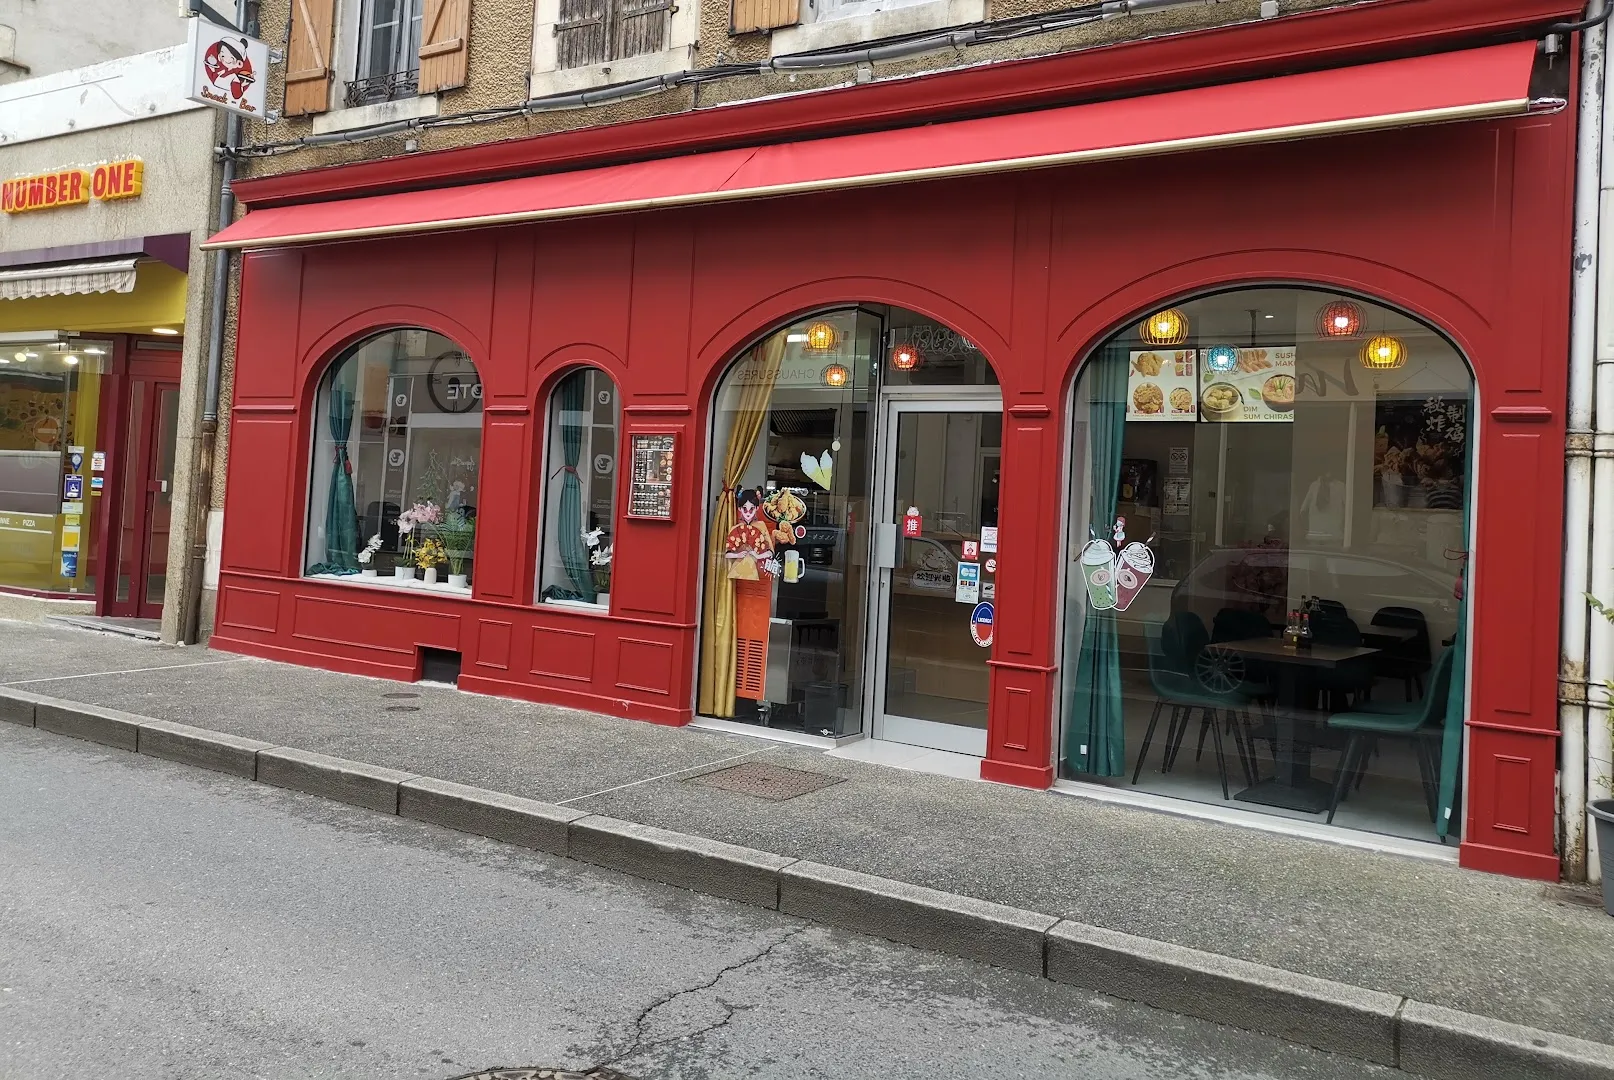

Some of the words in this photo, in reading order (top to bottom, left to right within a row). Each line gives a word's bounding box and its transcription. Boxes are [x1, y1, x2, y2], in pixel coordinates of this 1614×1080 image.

[200, 85, 228, 105] Snack
[239, 97, 257, 112] Bar
[1, 171, 85, 212] NUMBER
[92, 161, 138, 199] ONE
[22, 518, 36, 528] PIZZA
[906, 518, 919, 532] 推
